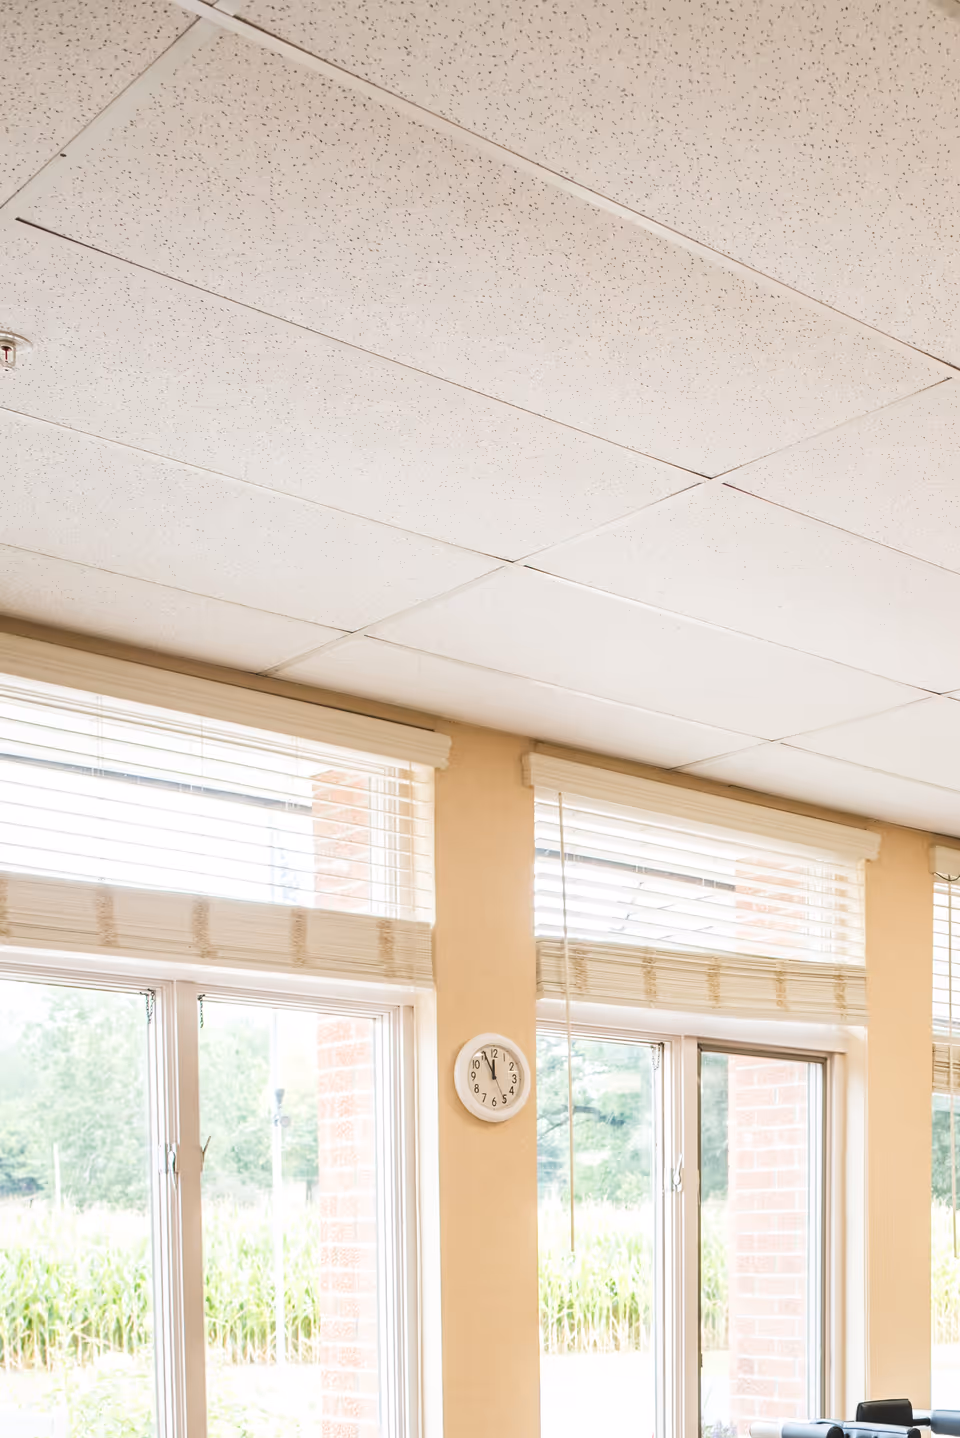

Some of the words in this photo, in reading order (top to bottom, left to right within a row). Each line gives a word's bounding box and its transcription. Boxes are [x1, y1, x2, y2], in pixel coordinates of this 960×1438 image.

[491, 1048, 498, 1059] 12
[472, 1059, 480, 1069] 10
[509, 1061, 515, 1071] 2
[471, 1071, 476, 1081] 9
[511, 1073, 517, 1084] 3
[474, 1083, 480, 1094] 8
[509, 1085, 514, 1096] 4
[481, 1092, 487, 1103] 7
[491, 1096, 497, 1107] 6
[502, 1094, 508, 1104] 5
